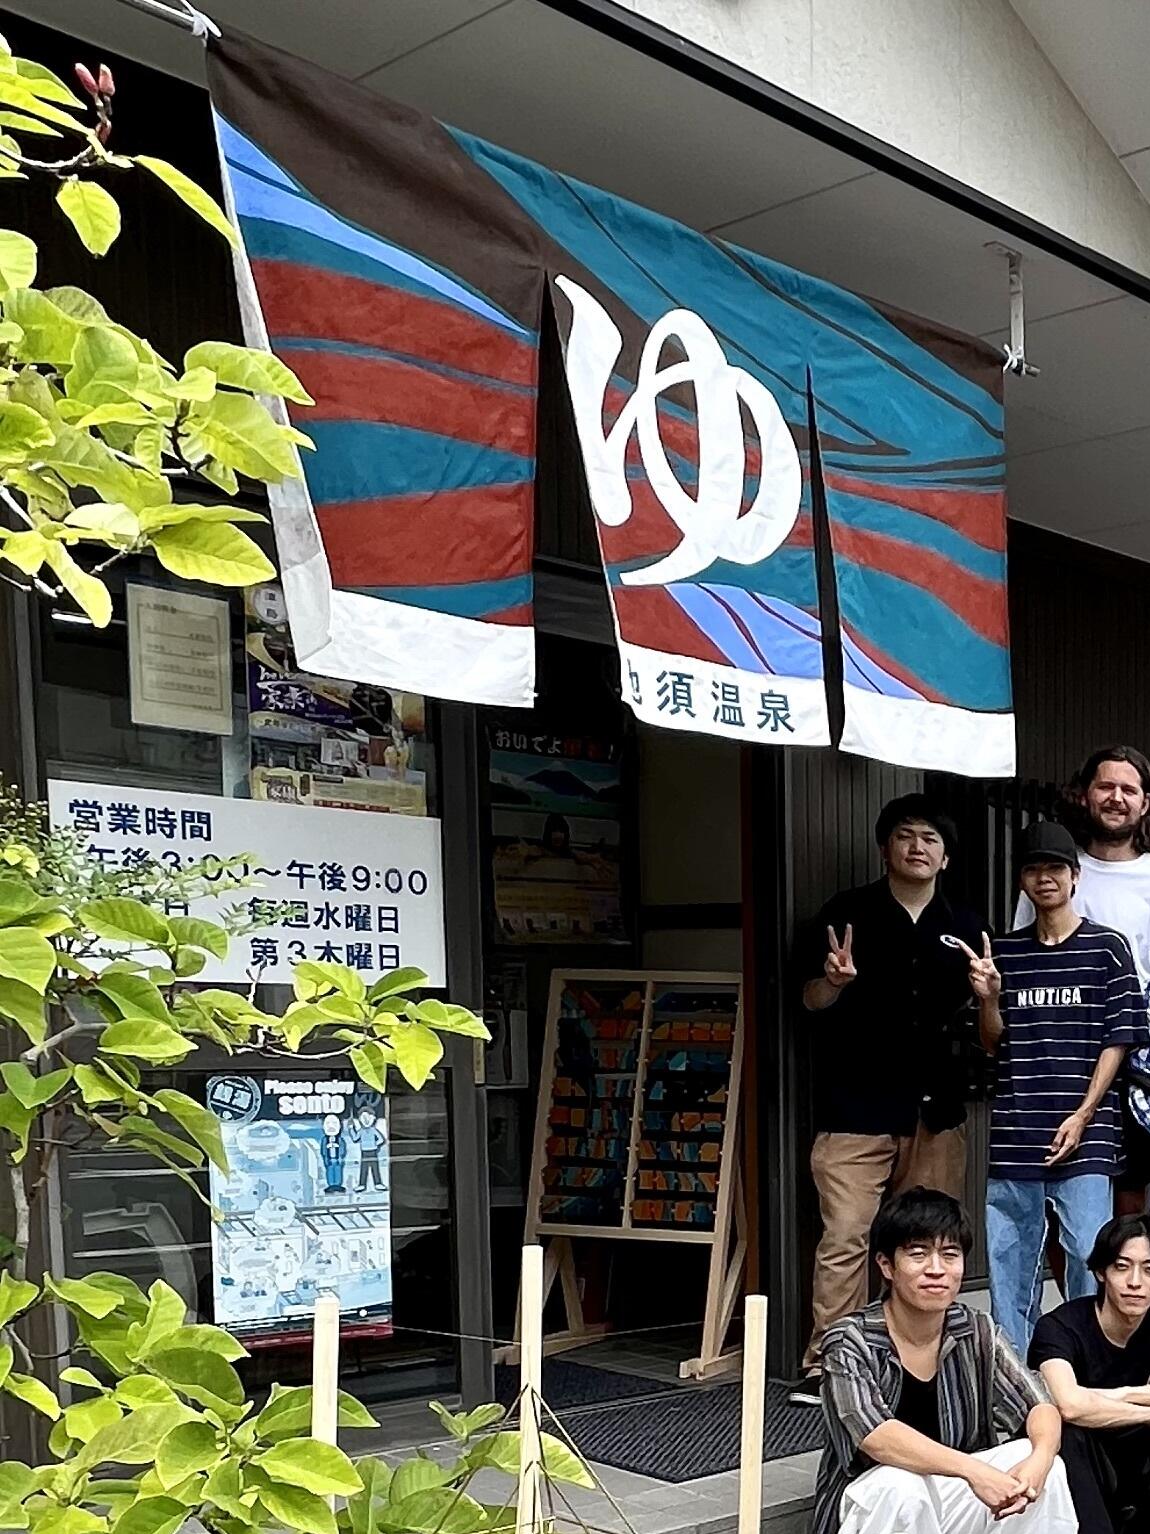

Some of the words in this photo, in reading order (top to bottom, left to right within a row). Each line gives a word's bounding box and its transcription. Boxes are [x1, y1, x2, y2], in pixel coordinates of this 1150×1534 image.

[553, 273, 803, 587] ゆ
[68, 799, 212, 842] 営業時間
[250, 937, 400, 971] 第3木曜日
[278, 1093, 345, 1115] sento
